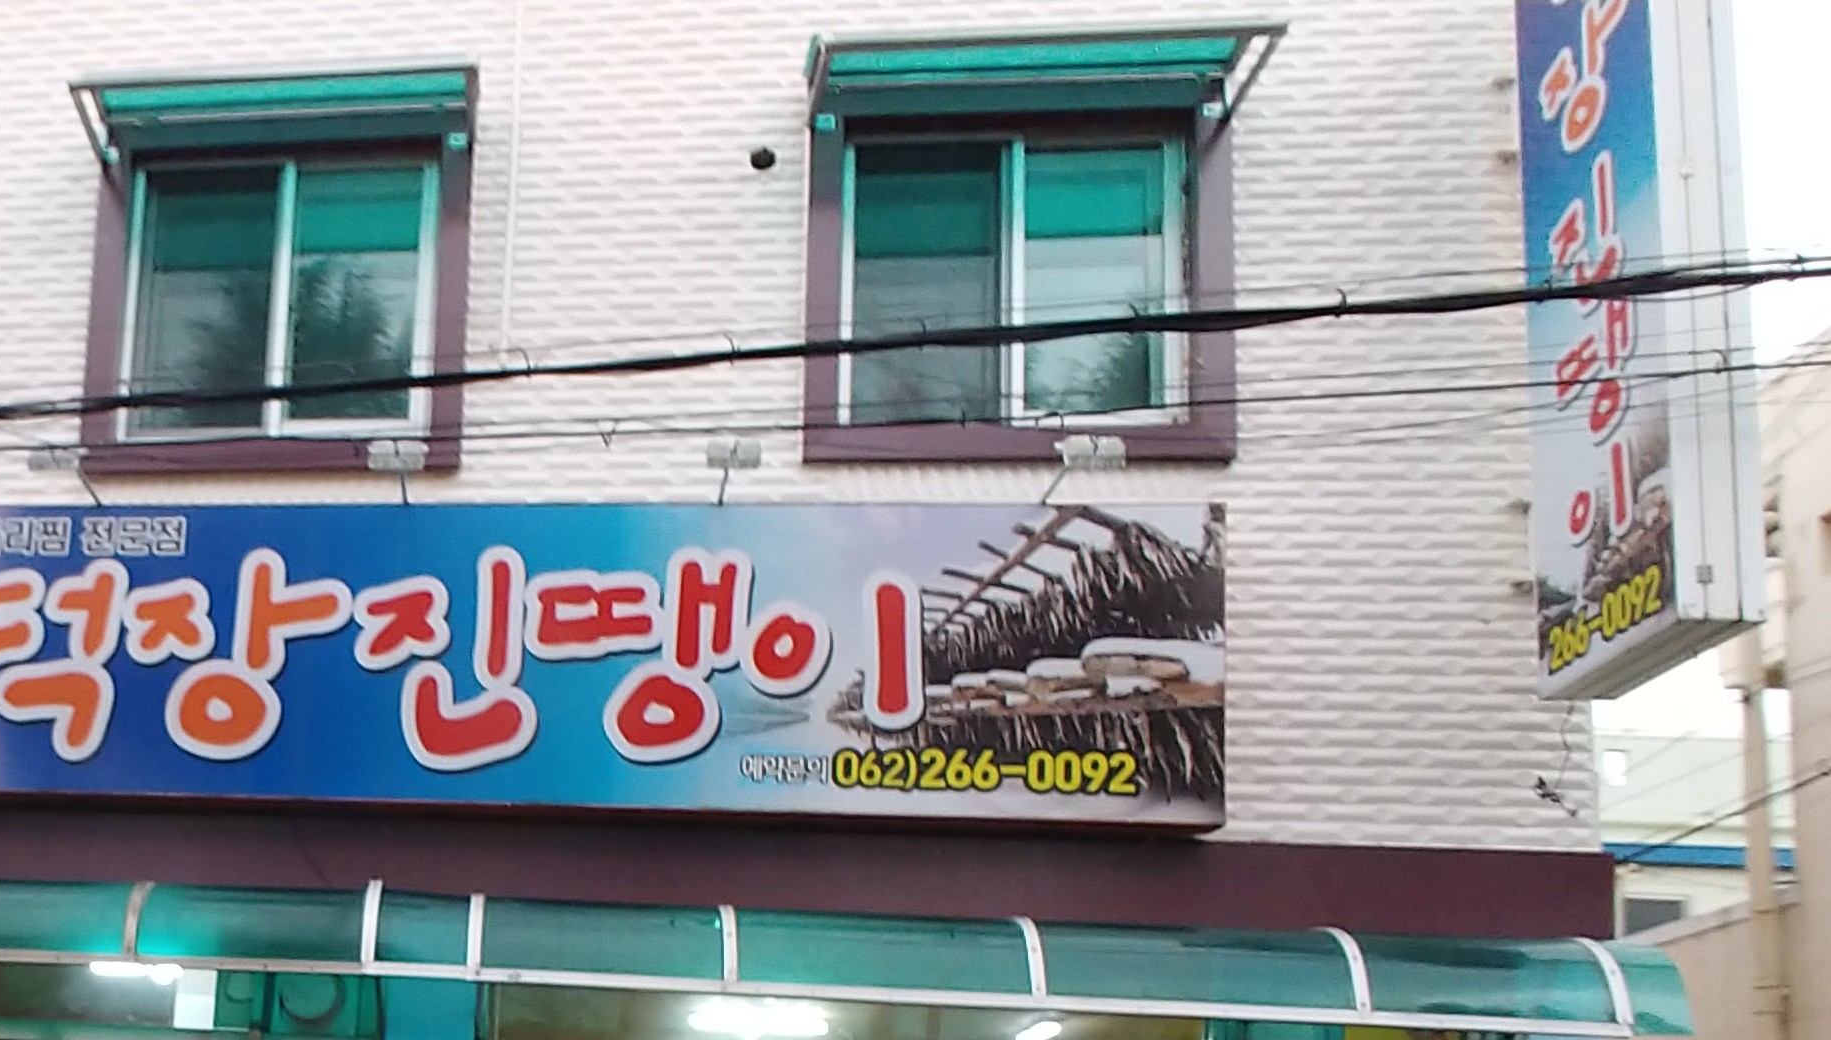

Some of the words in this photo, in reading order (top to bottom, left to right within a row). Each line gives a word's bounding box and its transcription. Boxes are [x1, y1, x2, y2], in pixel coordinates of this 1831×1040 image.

[81, 515, 187, 557] 전문점
[1547, 564, 1663, 675] 266-0092
[832, 748, 1139, 795] 062)266-0092
